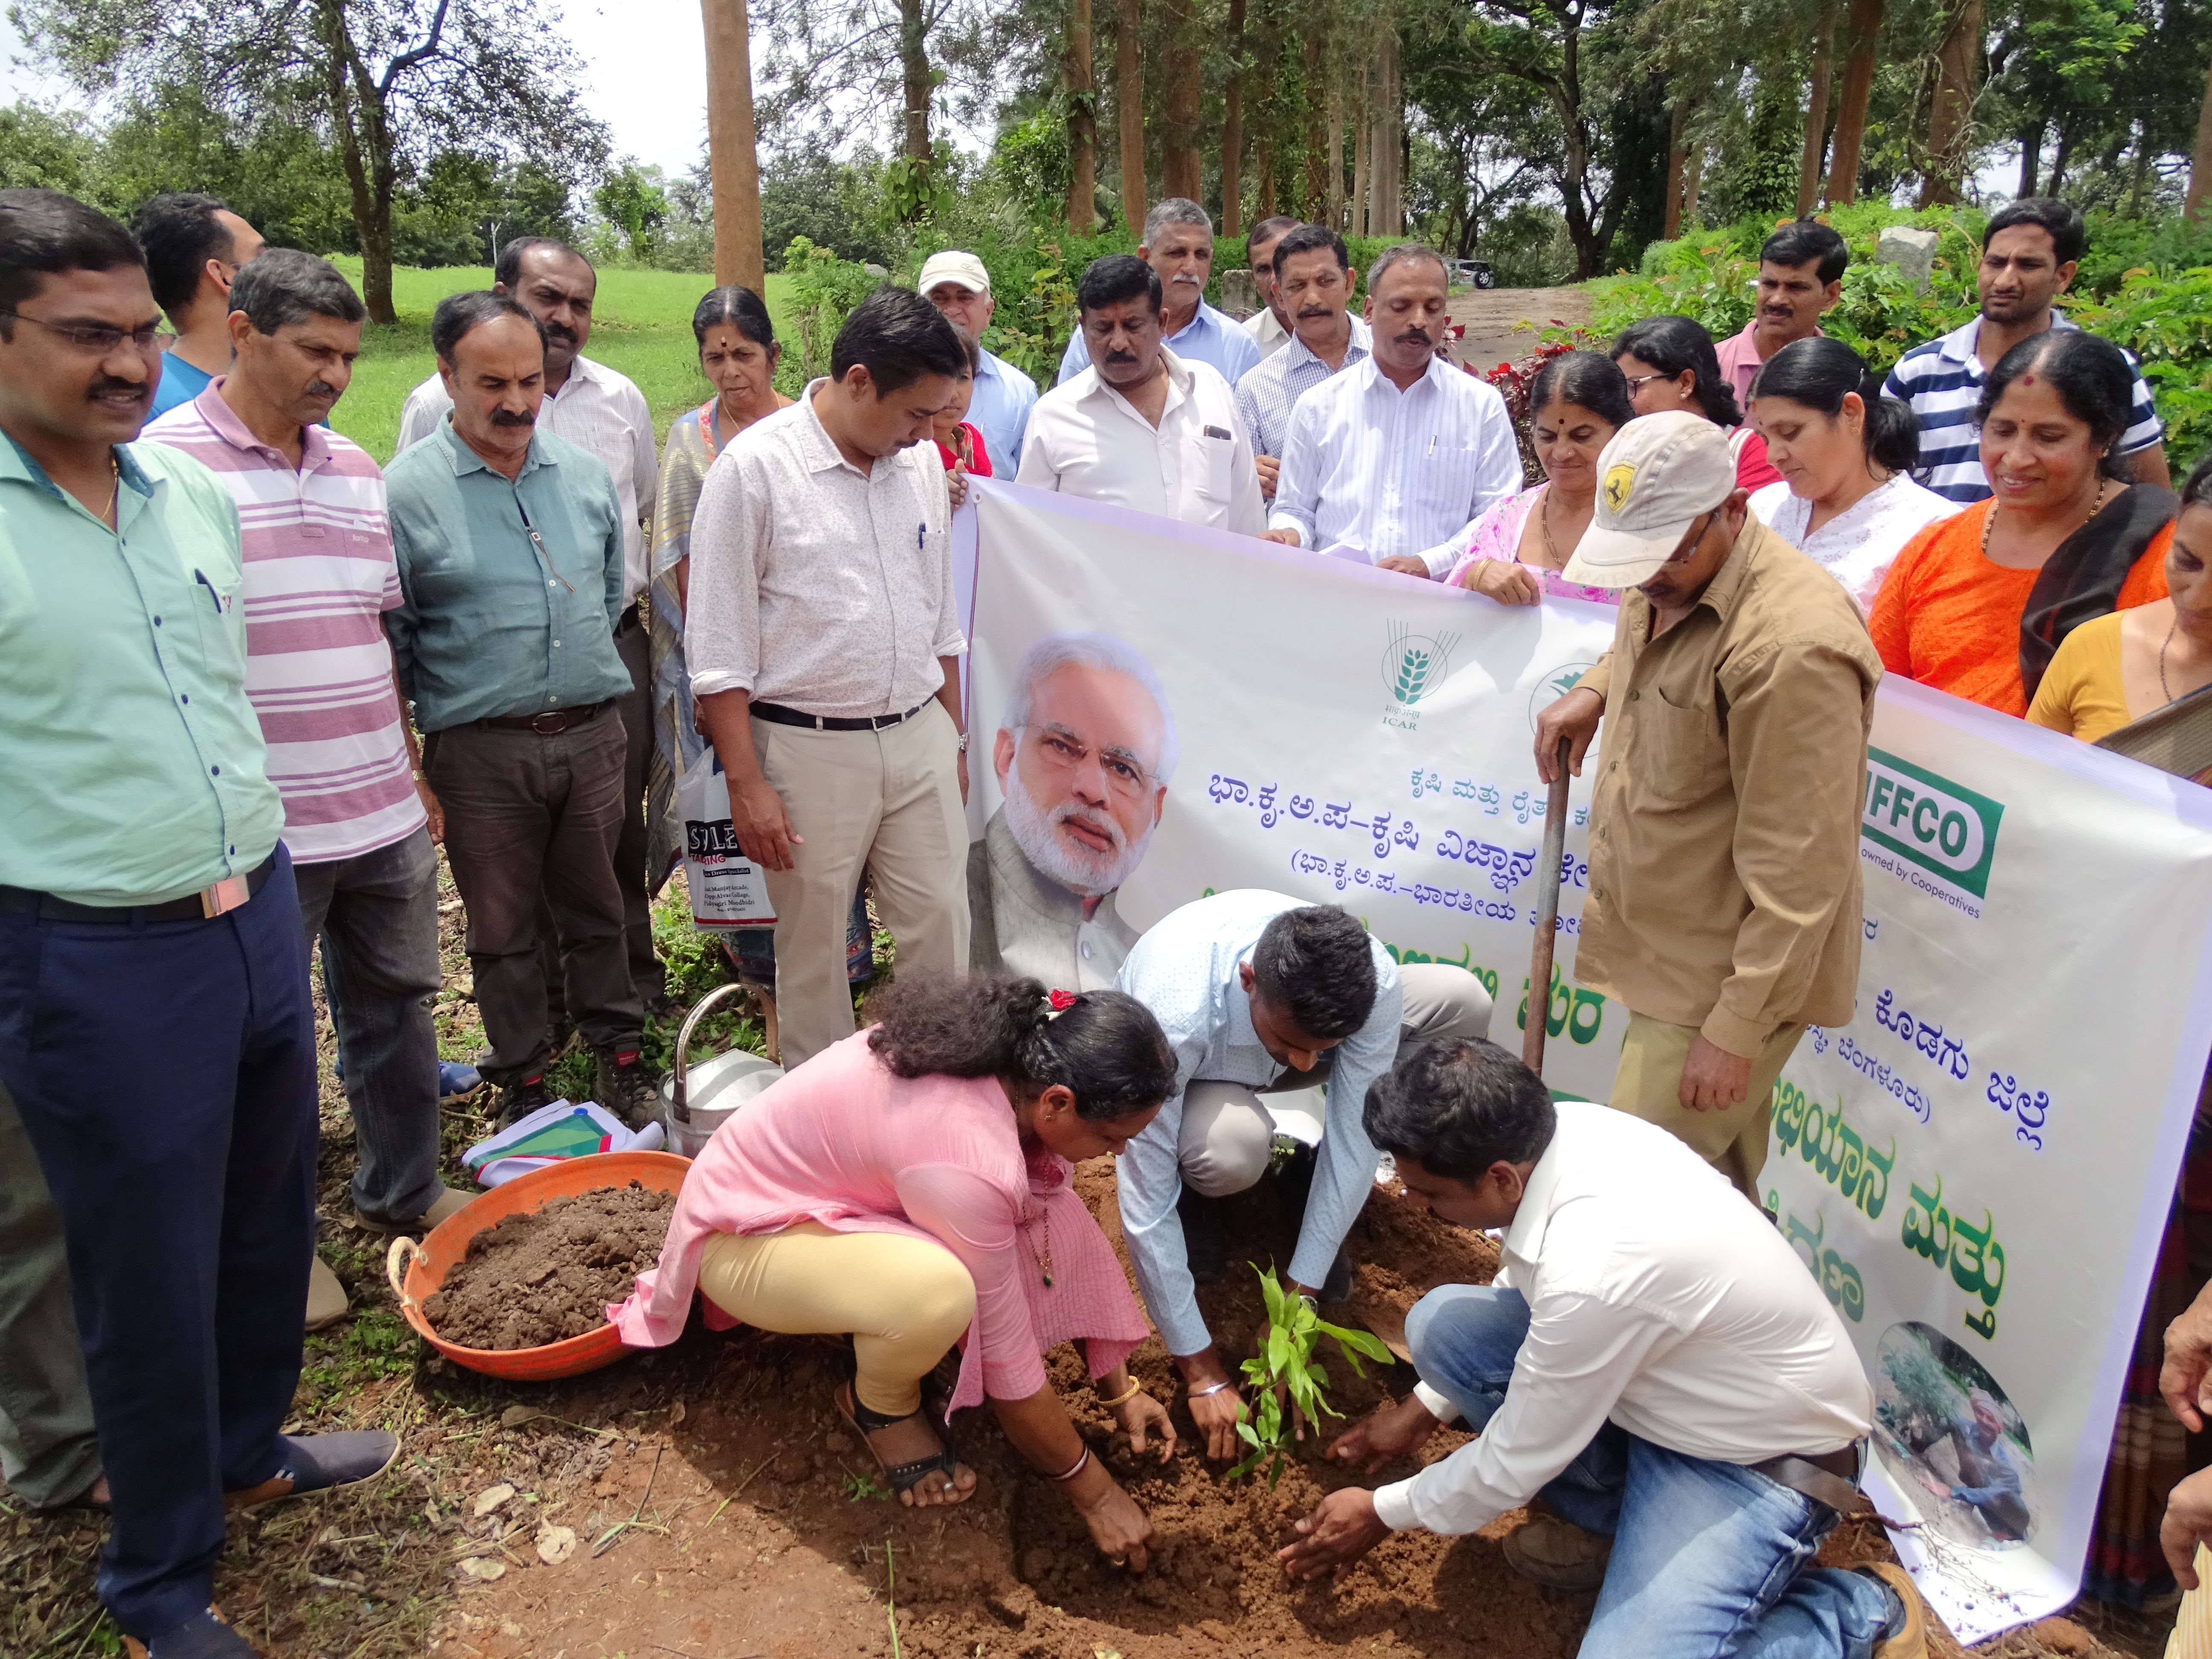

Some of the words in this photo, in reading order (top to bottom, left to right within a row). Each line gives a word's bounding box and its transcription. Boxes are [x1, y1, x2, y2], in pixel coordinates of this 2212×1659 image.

[1382, 716, 1417, 731] ICAR
[1411, 768, 1442, 798] ಕೃಷಿ
[1452, 779, 1499, 815] ಮತ್ತು
[1861, 848, 1894, 871] owned
[1896, 854, 1908, 881] by
[1911, 872, 1980, 918] Cooperatives
[1876, 989, 1969, 1080] ಕೊಡಗು
[1771, 1075, 1896, 1219] ಭಿಯಾನ
[1902, 1173, 2005, 1339] ಮತ್ತು
